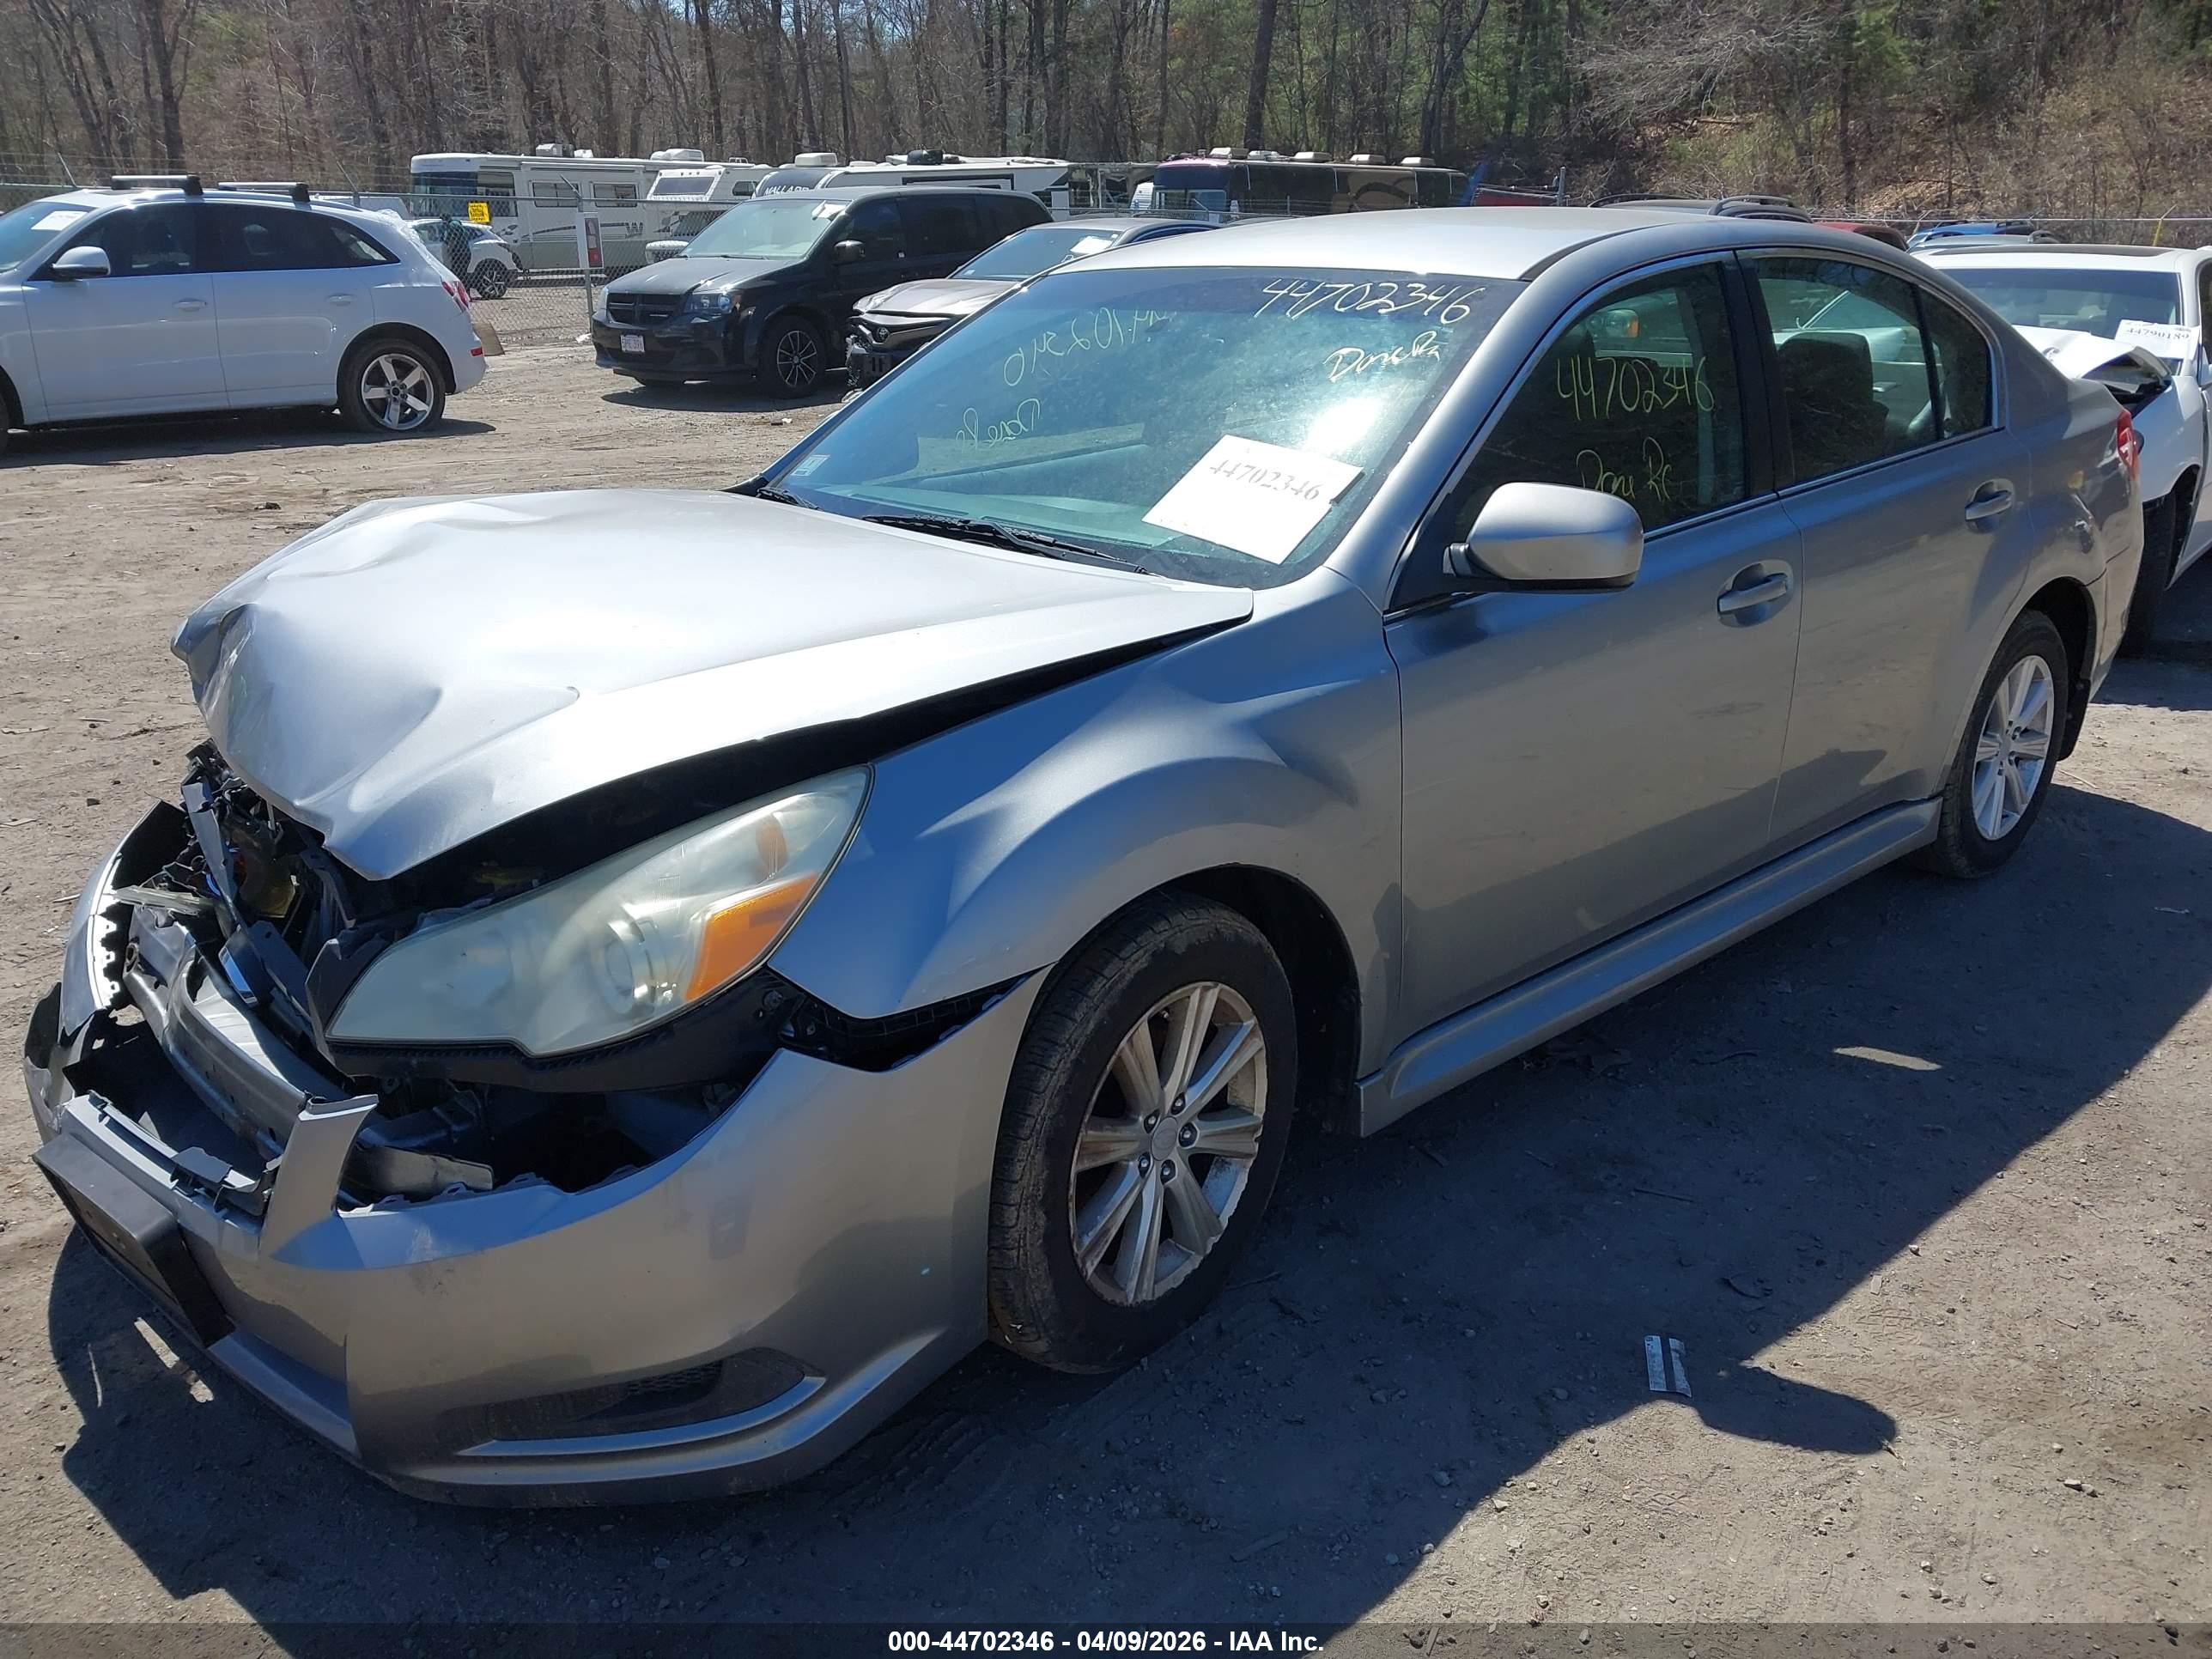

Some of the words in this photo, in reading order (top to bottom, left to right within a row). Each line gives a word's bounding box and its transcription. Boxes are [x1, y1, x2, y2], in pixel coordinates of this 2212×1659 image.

[1253, 278, 1486, 325] 44702346
[1557, 354, 1715, 421] 44702346
[1209, 459, 1324, 501] 44702346
